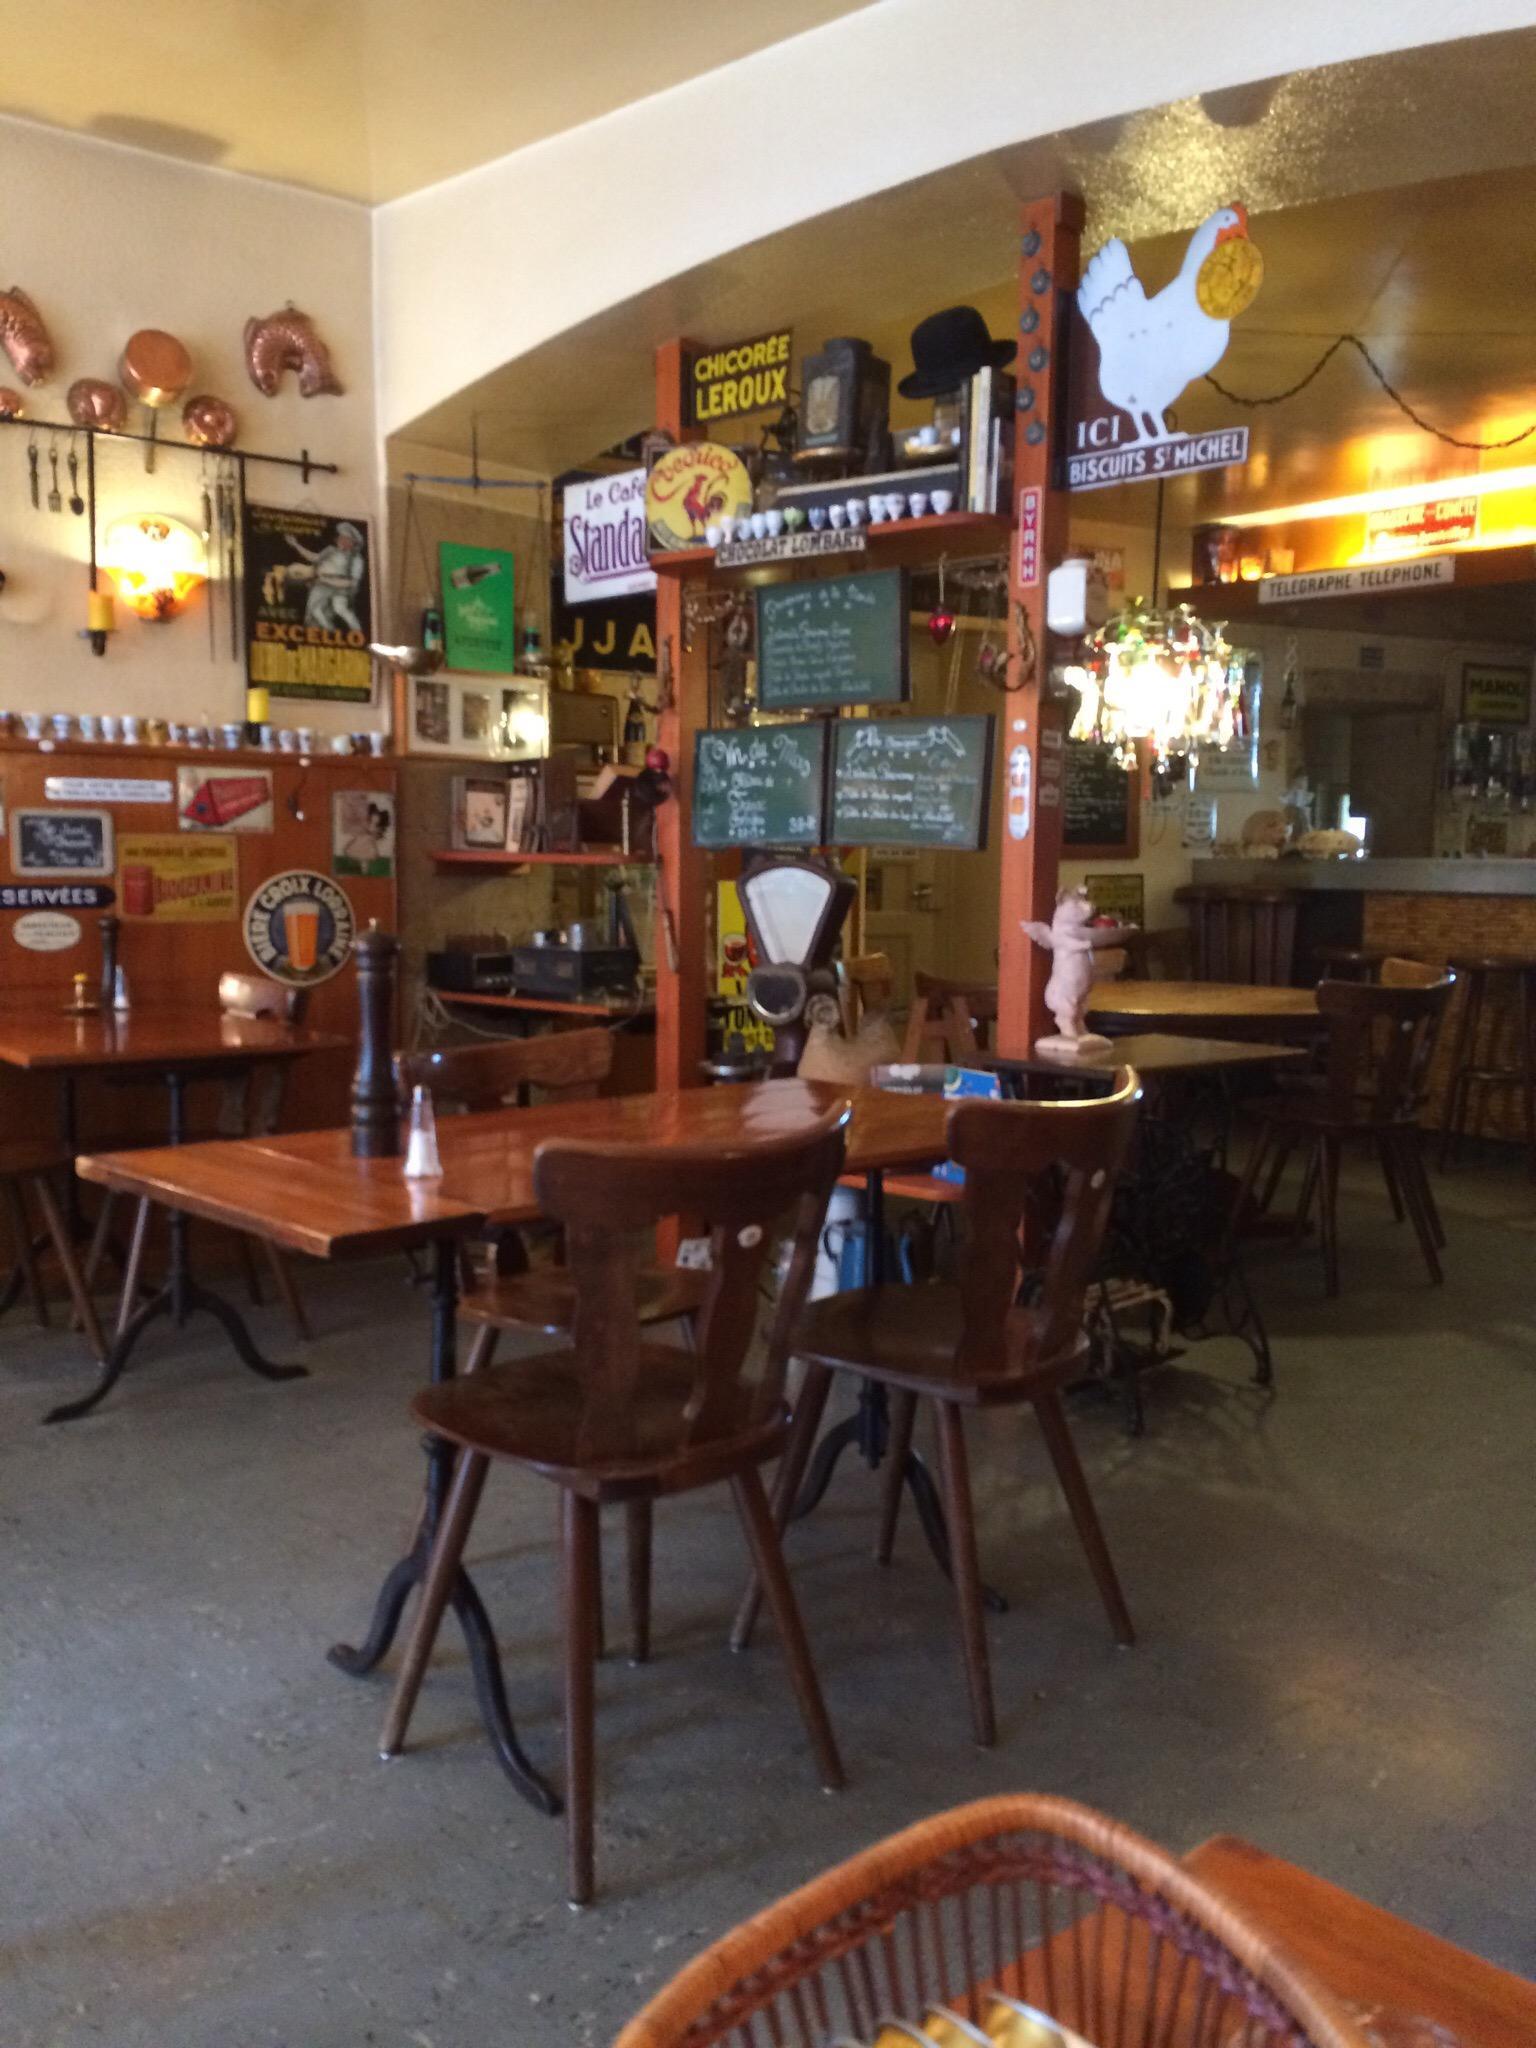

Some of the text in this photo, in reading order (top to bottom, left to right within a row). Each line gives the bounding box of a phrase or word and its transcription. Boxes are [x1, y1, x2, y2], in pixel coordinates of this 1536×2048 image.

[694, 334, 790, 382] CHICORÉE
[696, 365, 788, 419] LEROUX
[1077, 414, 1120, 448] ICI
[1069, 450, 1146, 485] BISCUITS
[1174, 433, 1240, 467] MICHEL
[586, 489, 603, 510] Le
[569, 508, 644, 577] Standa
[719, 538, 787, 567] CHOCOLAT
[1023, 494, 1037, 580] BYRRH
[1359, 561, 1442, 587] TELEPHONE
[255, 621, 365, 647] EXCELLO
[259, 877, 310, 909] CROIX
